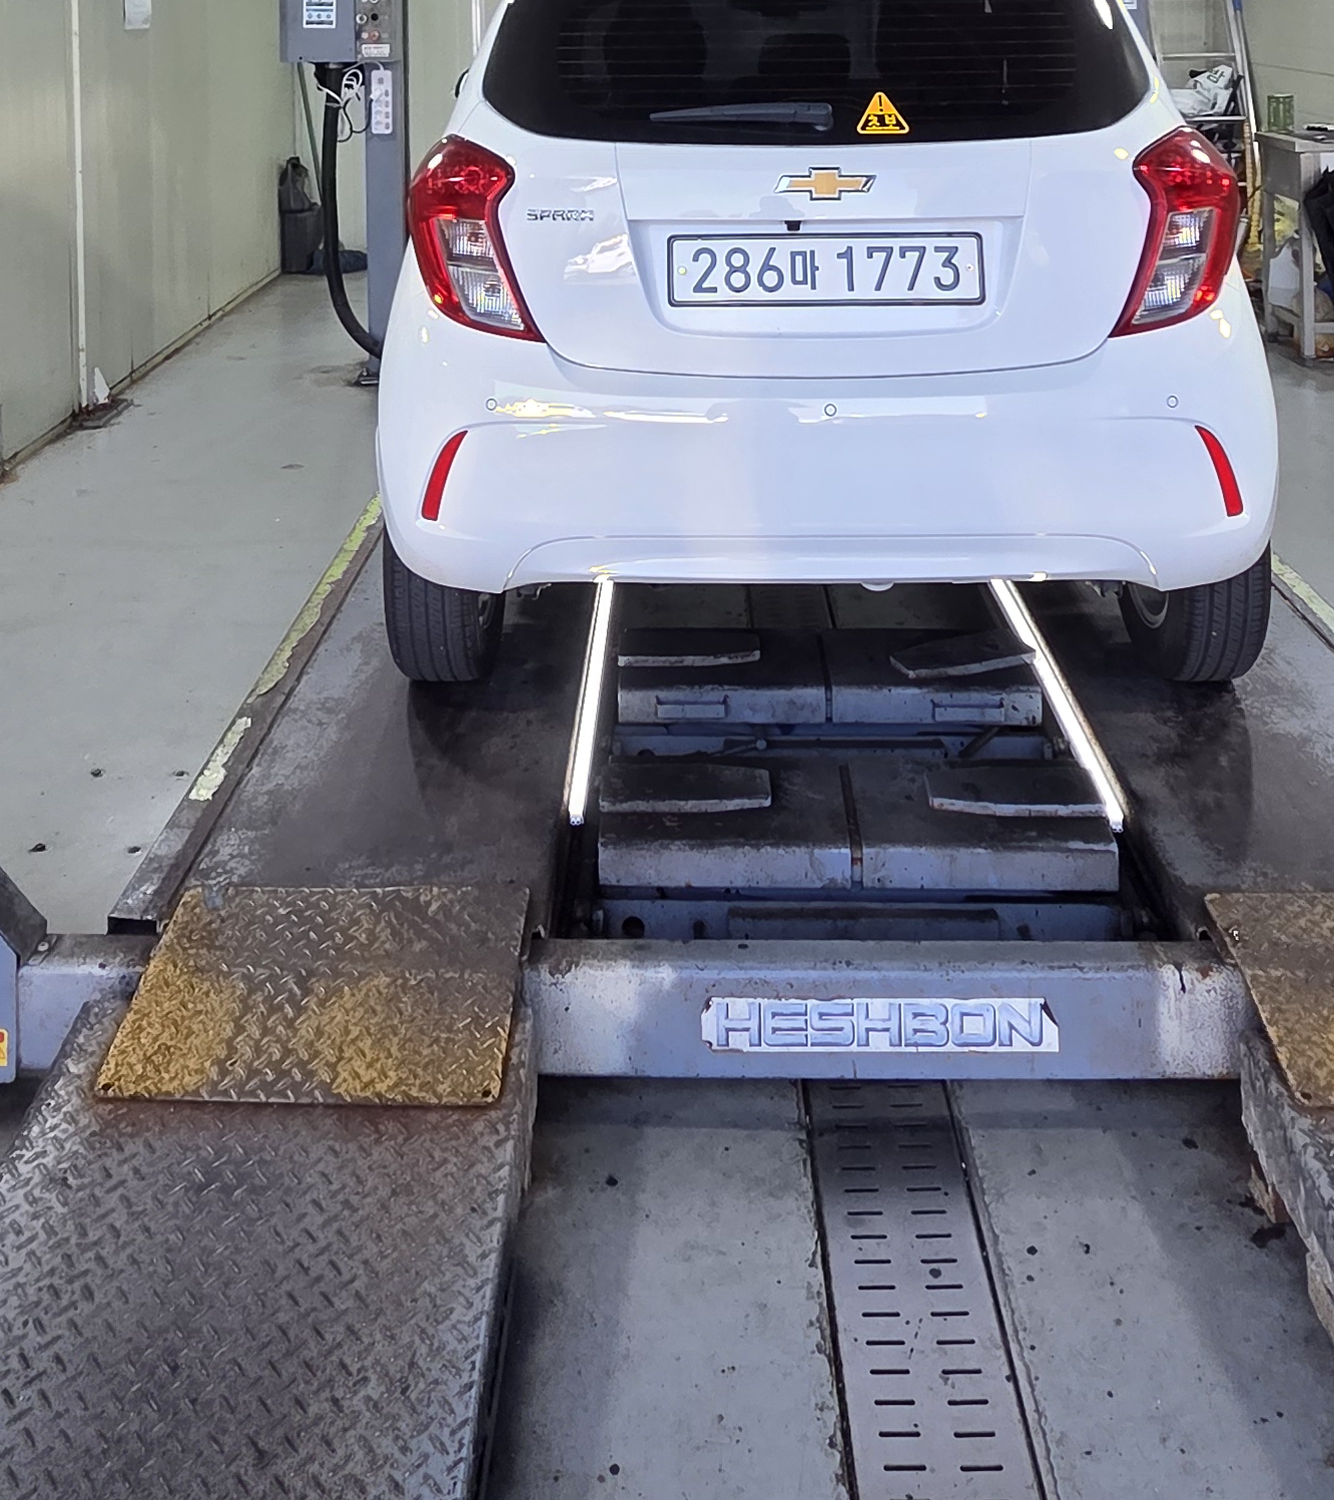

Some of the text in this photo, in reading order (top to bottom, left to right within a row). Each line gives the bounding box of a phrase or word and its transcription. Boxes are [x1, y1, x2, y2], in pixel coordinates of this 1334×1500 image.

[866, 114, 900, 131] 초보
[691, 244, 961, 293] 286마 1773
[715, 1001, 1044, 1048] HESHBON
